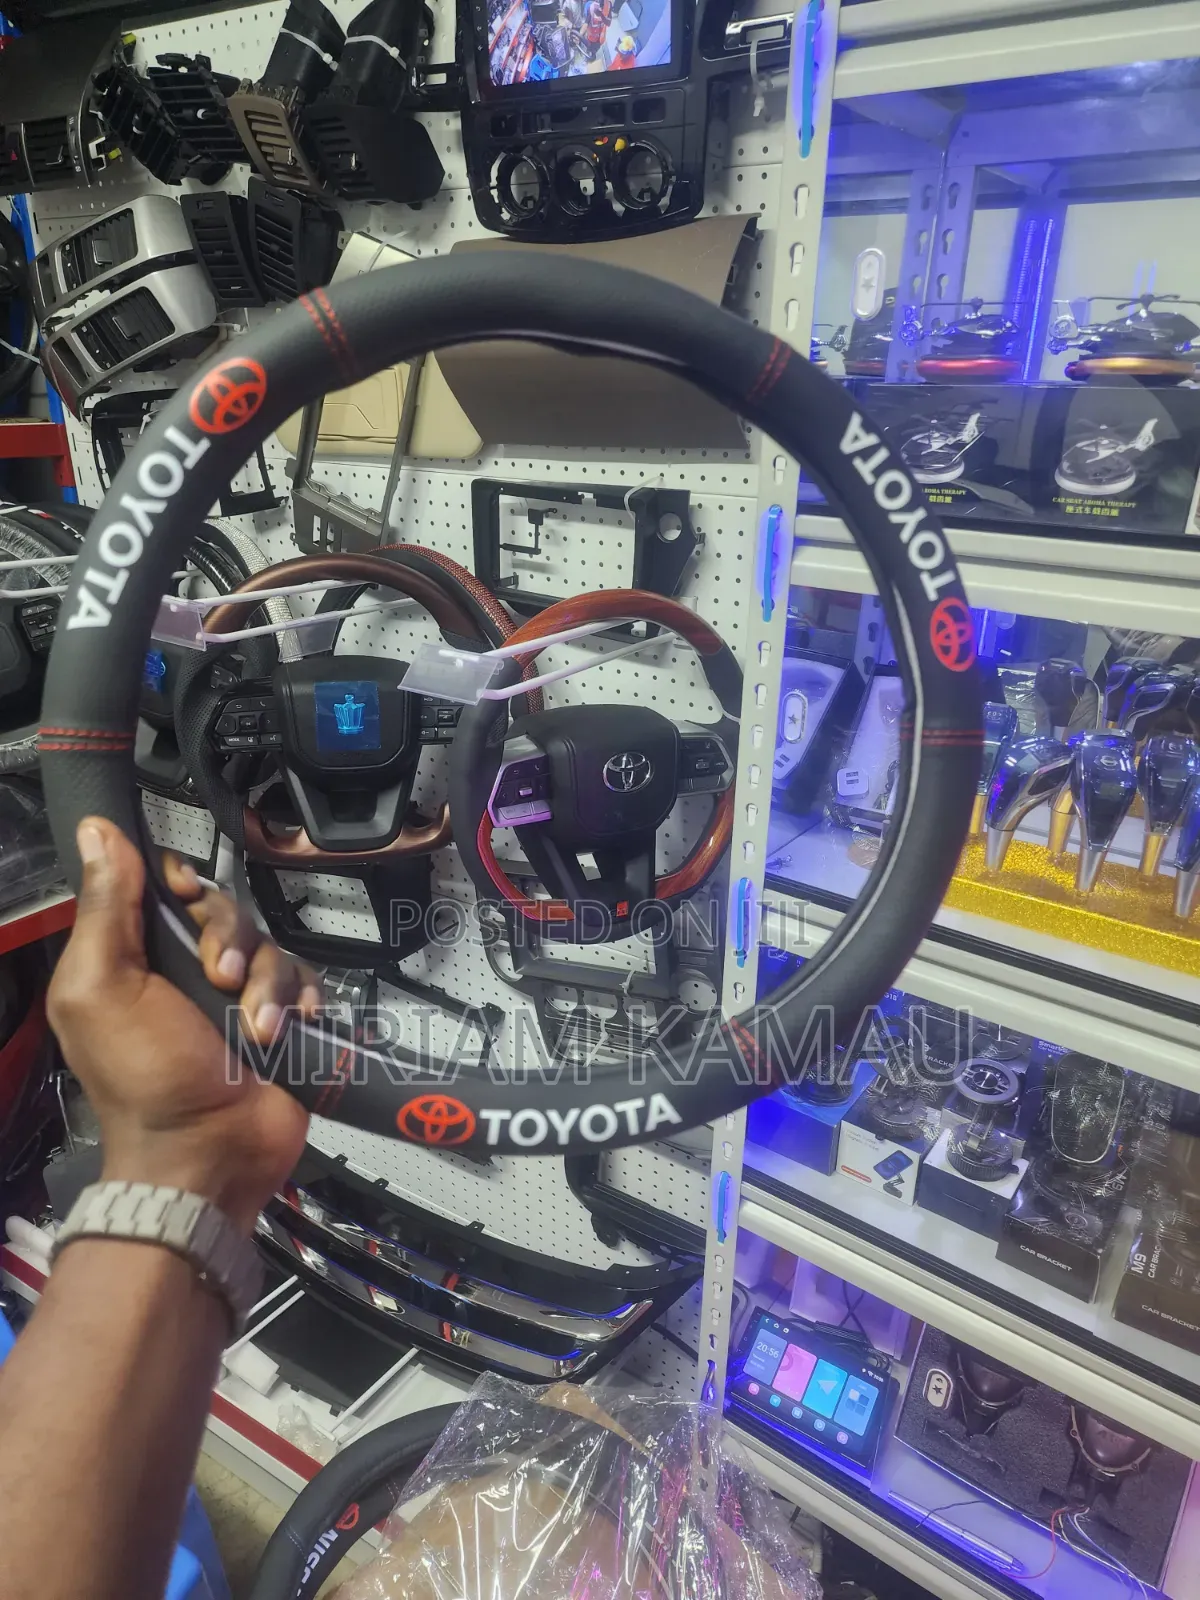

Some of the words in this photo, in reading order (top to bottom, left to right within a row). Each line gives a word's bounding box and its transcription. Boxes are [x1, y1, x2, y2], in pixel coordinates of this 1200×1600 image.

[839, 411, 956, 602] TOYOTA
[1107, 501, 1136, 509] THERAPY
[66, 425, 211, 630] TOYOTA
[924, 1054, 957, 1069] BRACKE
[479, 1092, 683, 1147] TOYOTA
[1020, 1245, 1036, 1256] CAR
[1036, 1252, 1072, 1272] BRACKET
[1131, 1253, 1147, 1275] M9
[1148, 1263, 1158, 1279] CAR
[1141, 1304, 1159, 1316] CAR
[756, 1341, 779, 1359] 20:56
